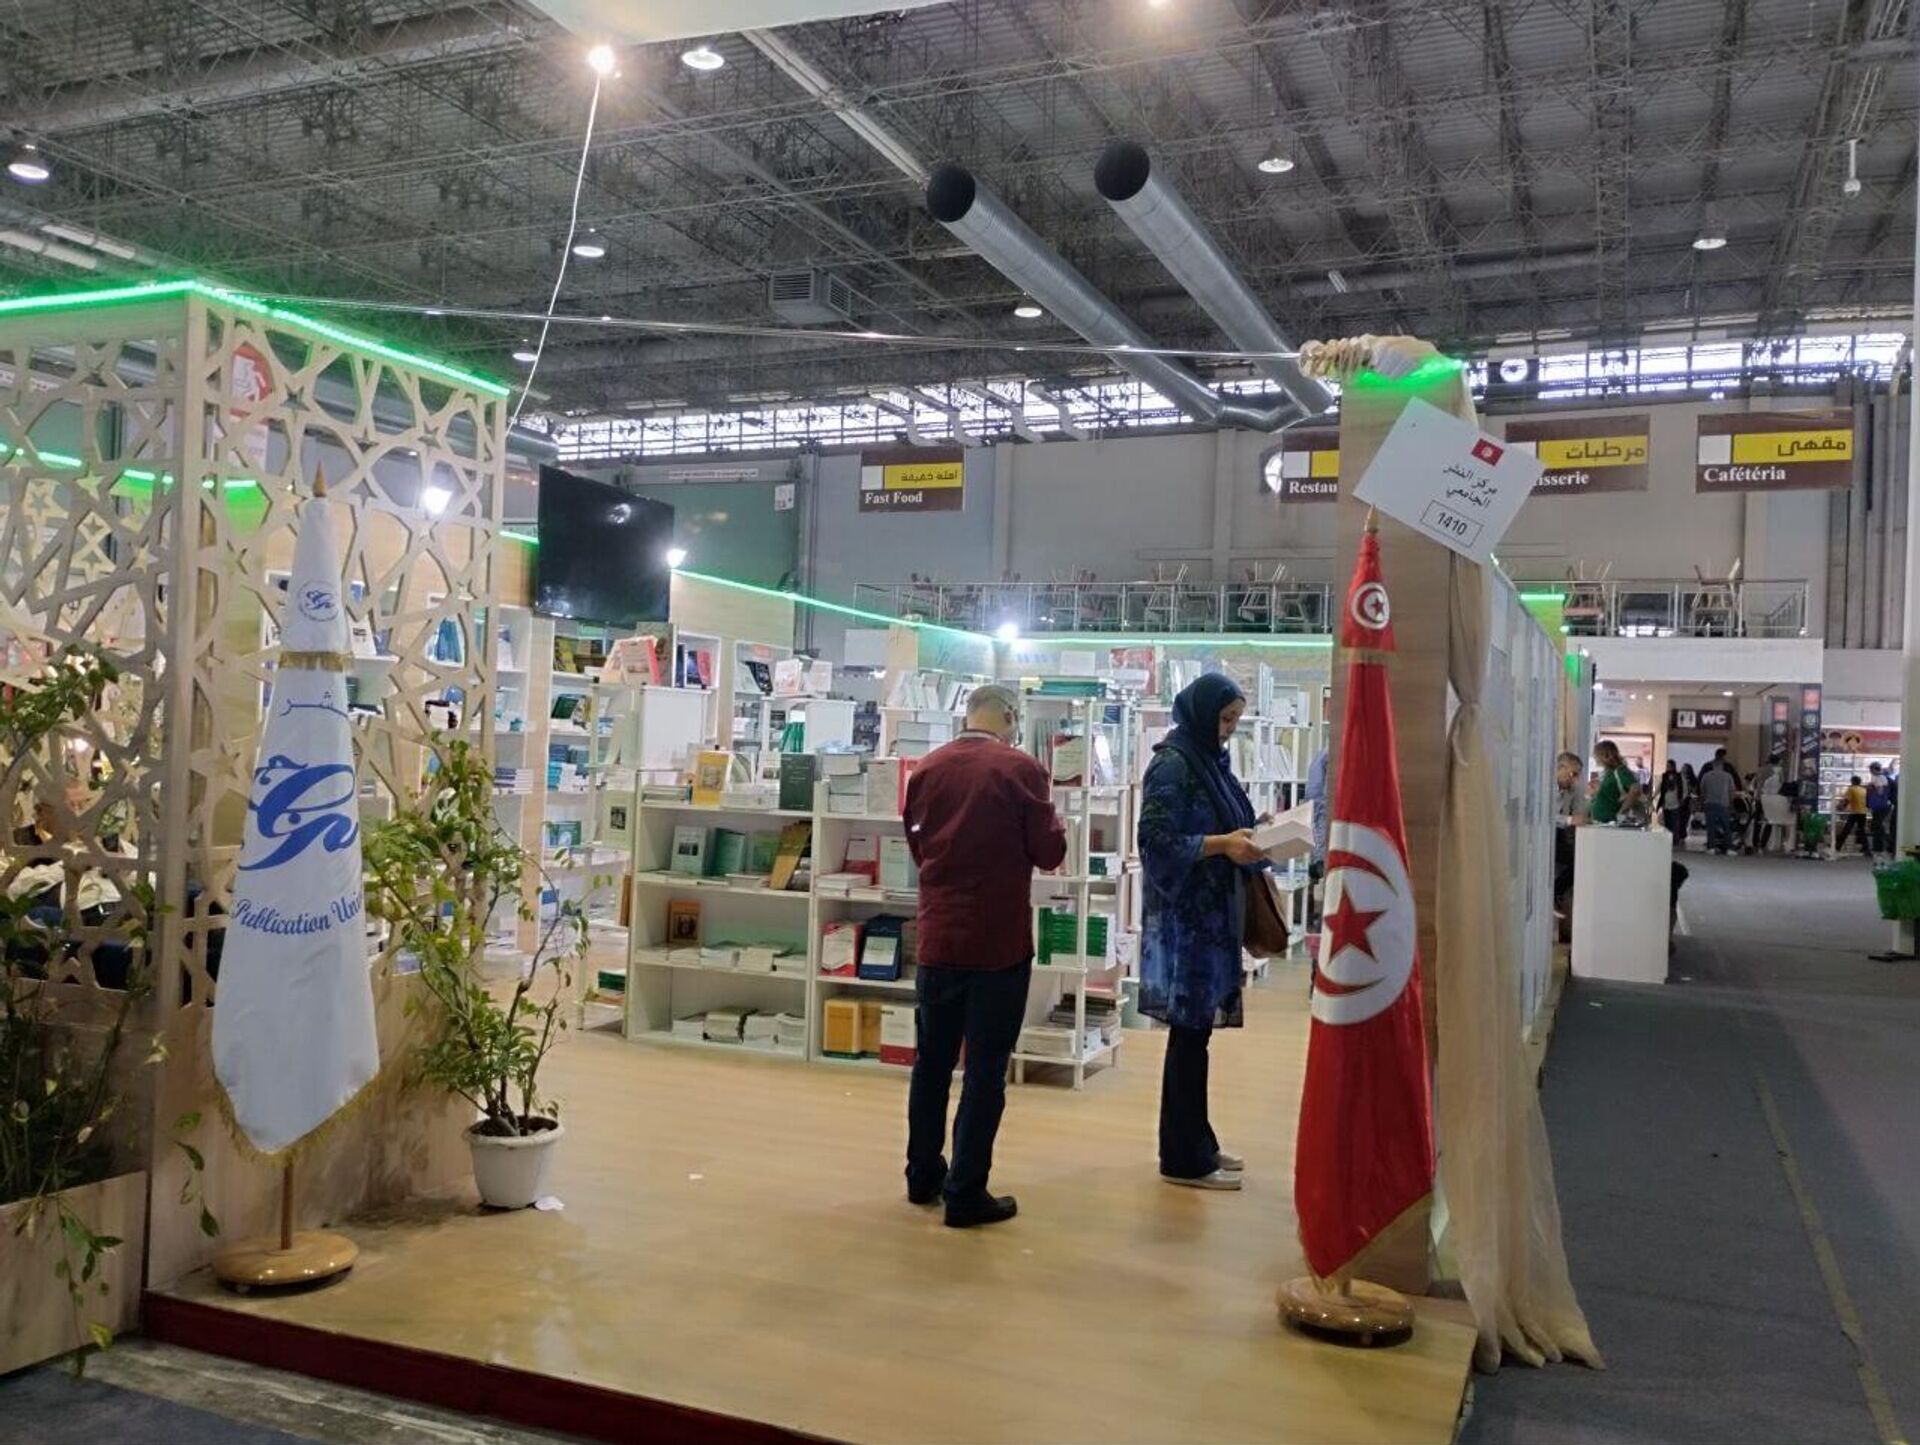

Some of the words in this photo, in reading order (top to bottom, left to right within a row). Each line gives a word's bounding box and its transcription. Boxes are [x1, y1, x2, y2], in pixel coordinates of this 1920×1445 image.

[1566, 441, 1645, 462] مرطبات
[1442, 465, 1474, 481] النشر
[1703, 466, 1787, 482] Cafétéria
[1471, 478, 1498, 495] مركز
[864, 492, 890, 504] Fast
[893, 491, 923, 504] Food
[1446, 488, 1491, 509] الجامعي
[1437, 512, 1468, 535] 1410
[1701, 714, 1727, 725] WC
[231, 898, 331, 935] Publication
